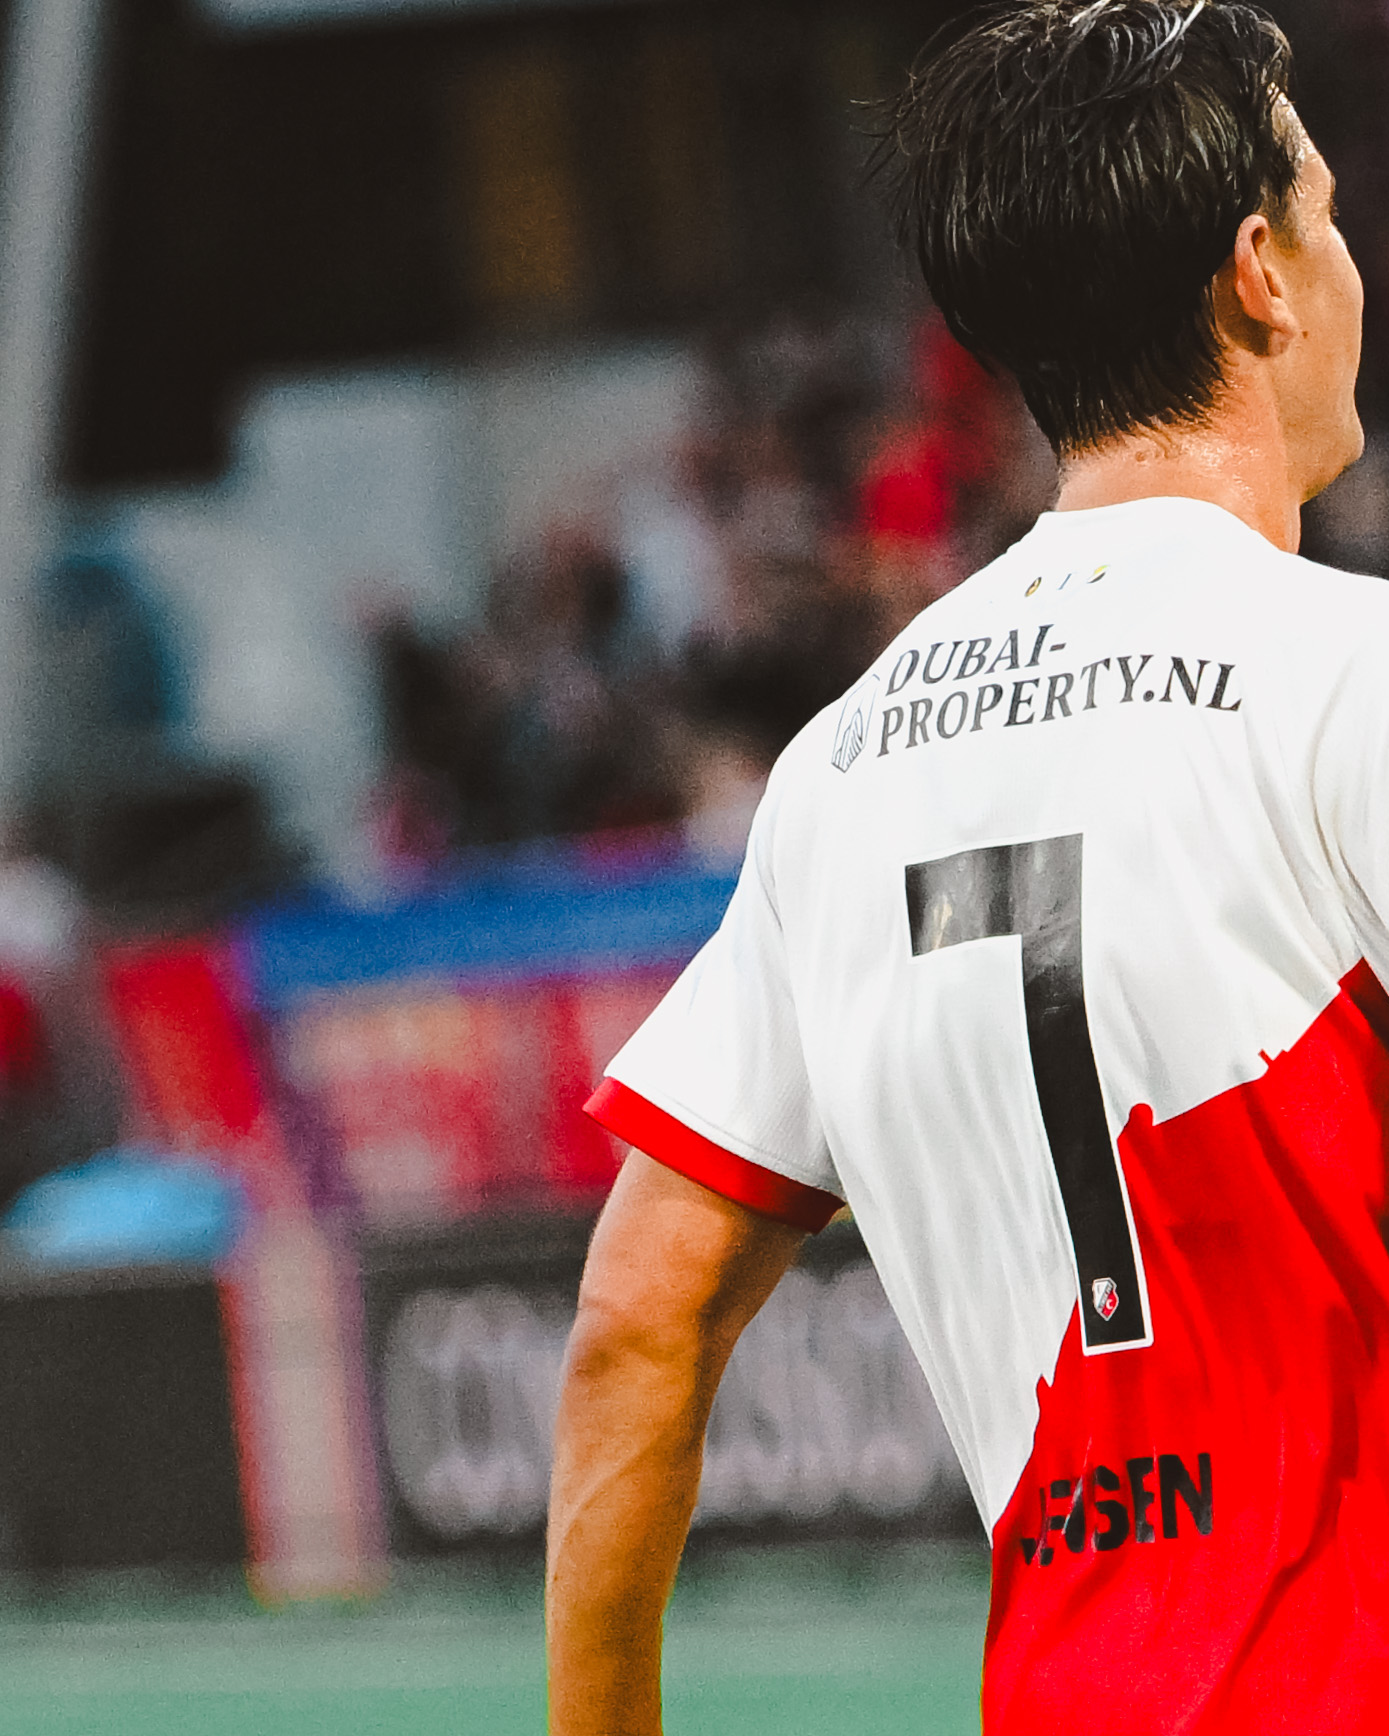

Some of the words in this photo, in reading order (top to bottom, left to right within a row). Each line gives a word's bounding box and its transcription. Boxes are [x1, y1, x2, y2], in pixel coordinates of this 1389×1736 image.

[877, 655, 1242, 757] PROPERTY.NL
[885, 624, 1066, 696] DUBAI-
[904, 832, 1150, 1352] 7
